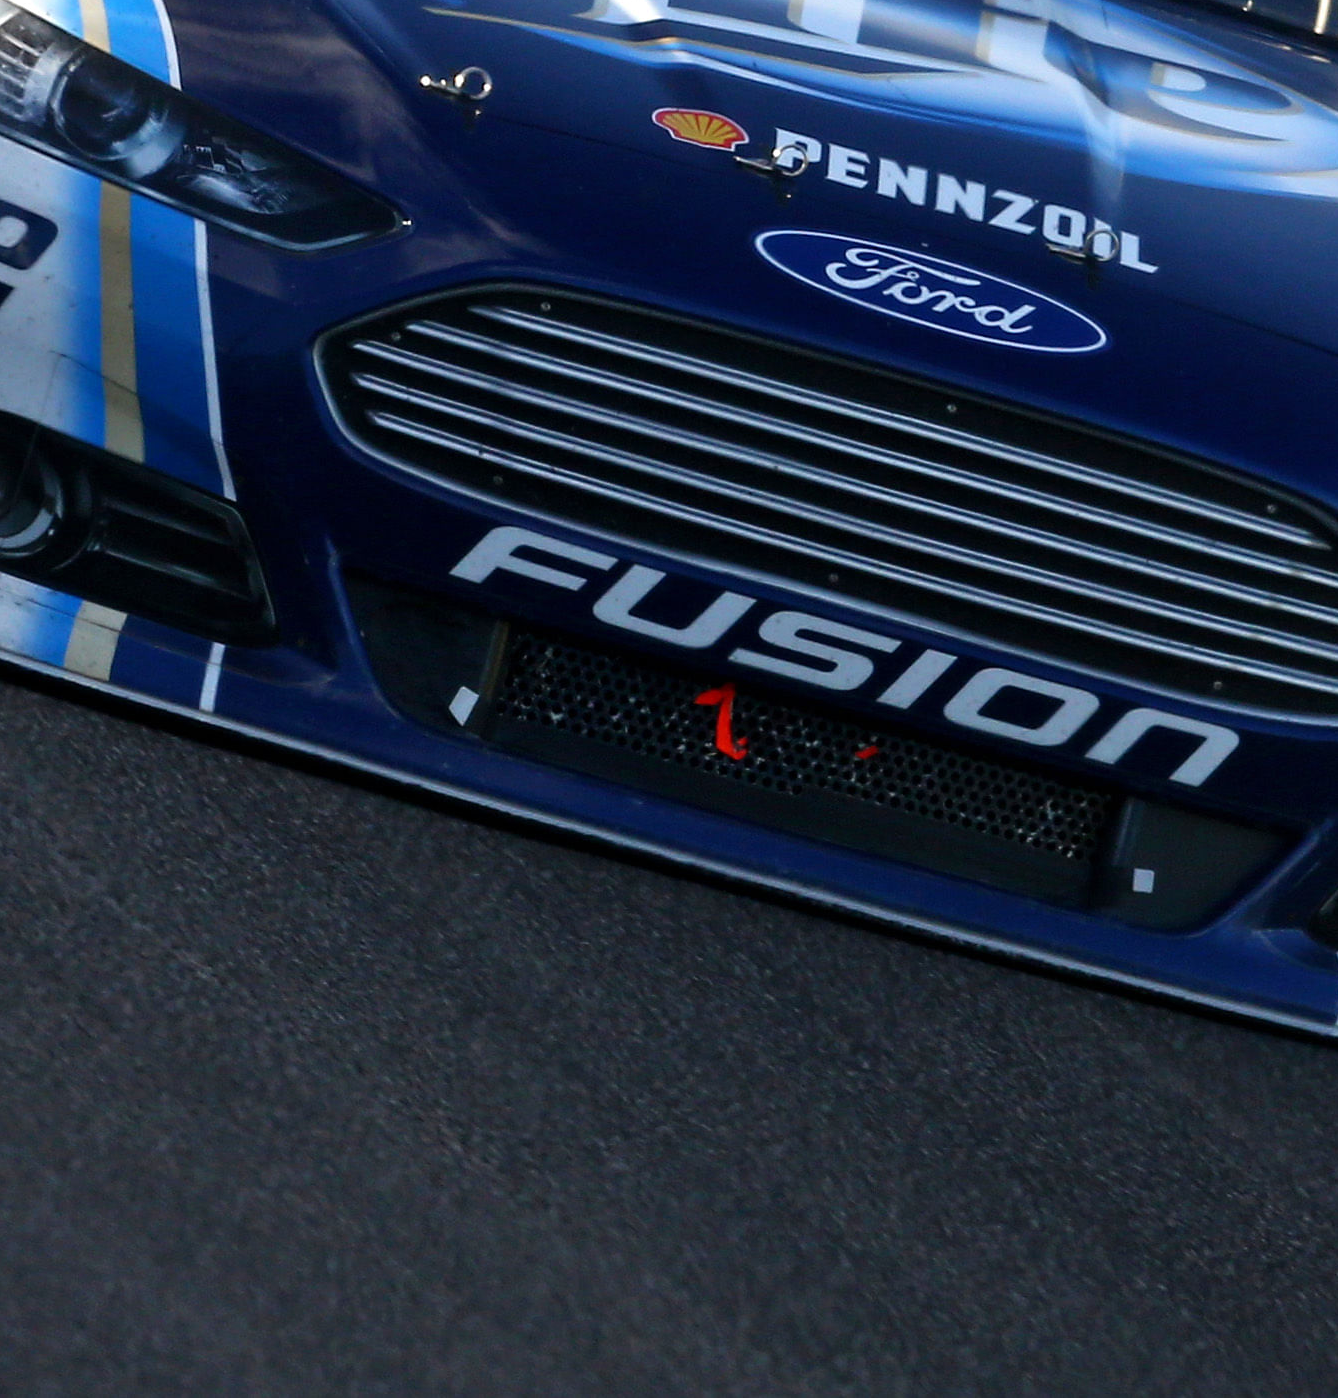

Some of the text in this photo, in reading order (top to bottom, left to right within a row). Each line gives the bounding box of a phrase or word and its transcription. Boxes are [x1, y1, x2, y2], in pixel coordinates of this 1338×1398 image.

[774, 127, 1160, 274] PENNZOIL
[824, 247, 1038, 335] Ford
[449, 524, 1241, 788] FUSION
